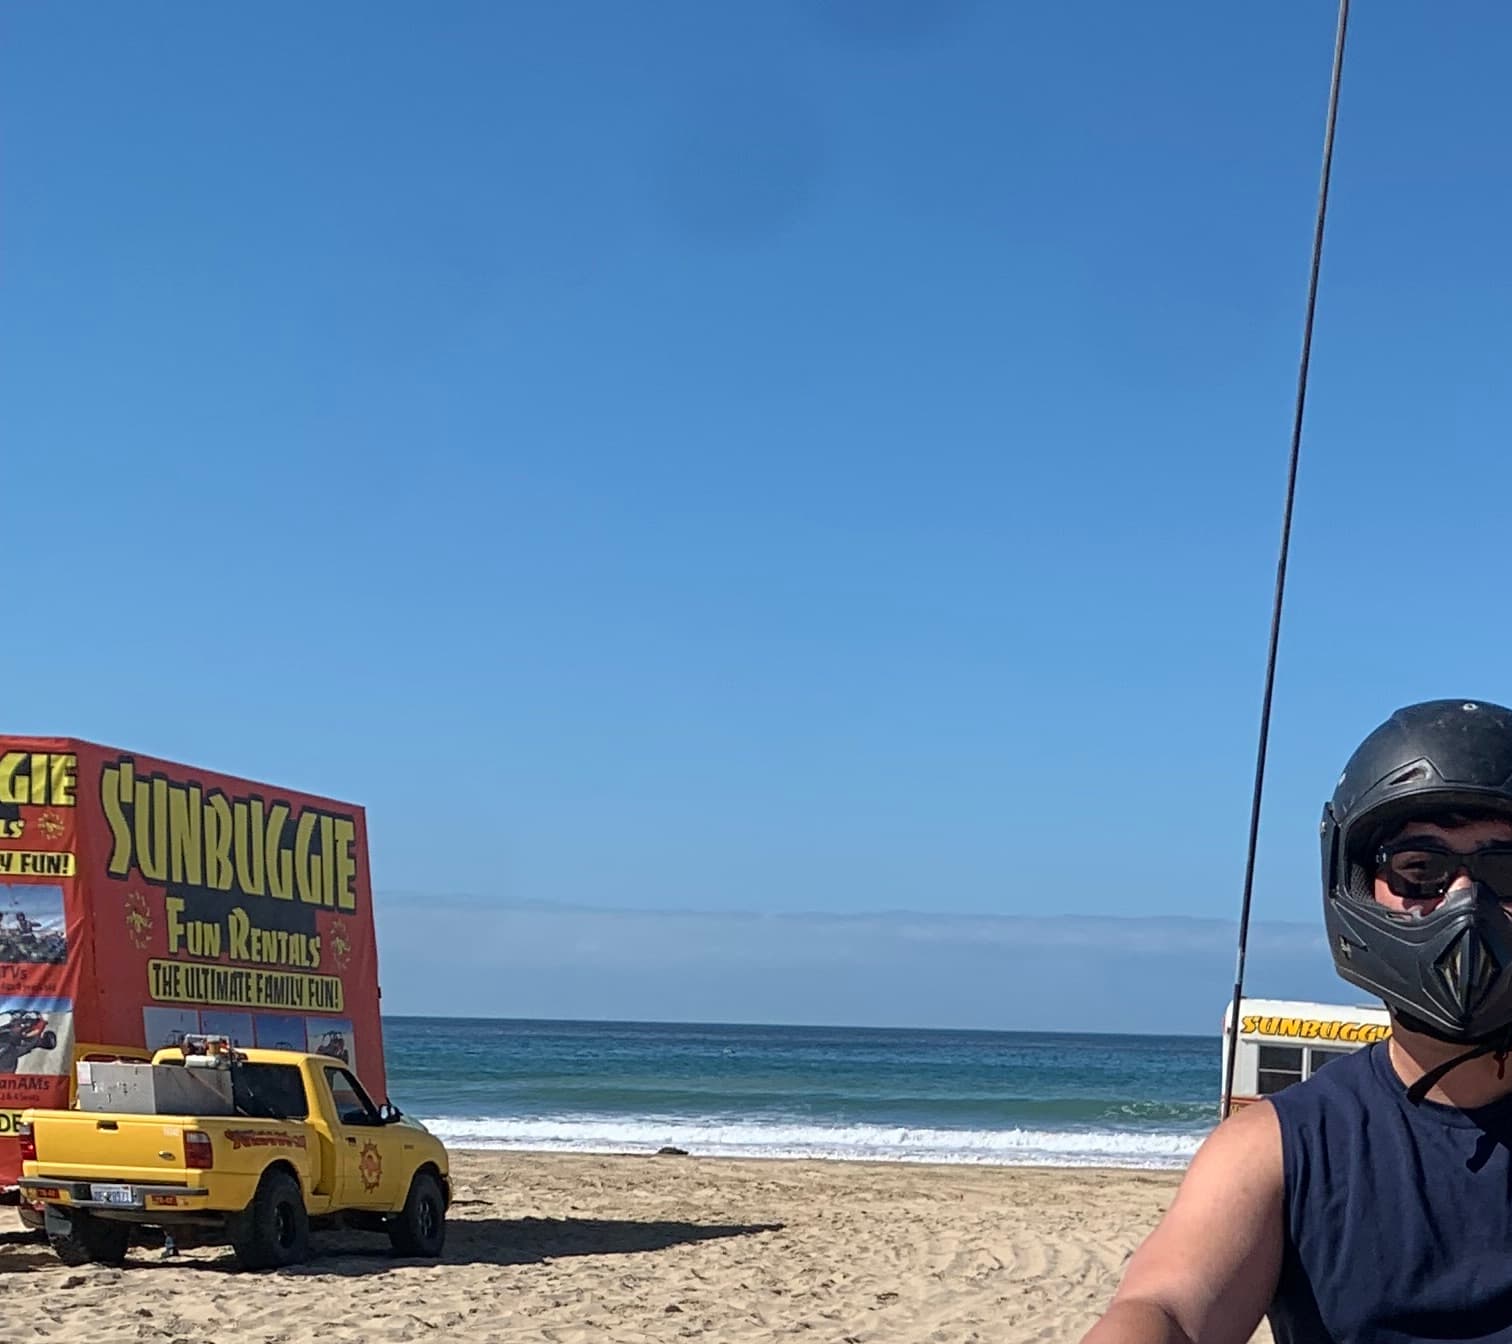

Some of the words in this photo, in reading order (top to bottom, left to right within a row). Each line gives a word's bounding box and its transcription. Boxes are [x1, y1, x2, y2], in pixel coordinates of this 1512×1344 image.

[101, 760, 356, 911] SUNBUGGIE
[21, 853, 69, 874] FUN!
[152, 963, 180, 997] THE
[185, 967, 251, 1002] ULTIMATE
[256, 973, 303, 1006] FAMILY
[308, 980, 339, 1010] FUN!
[1240, 1015, 1394, 1043] SUNBUGGY
